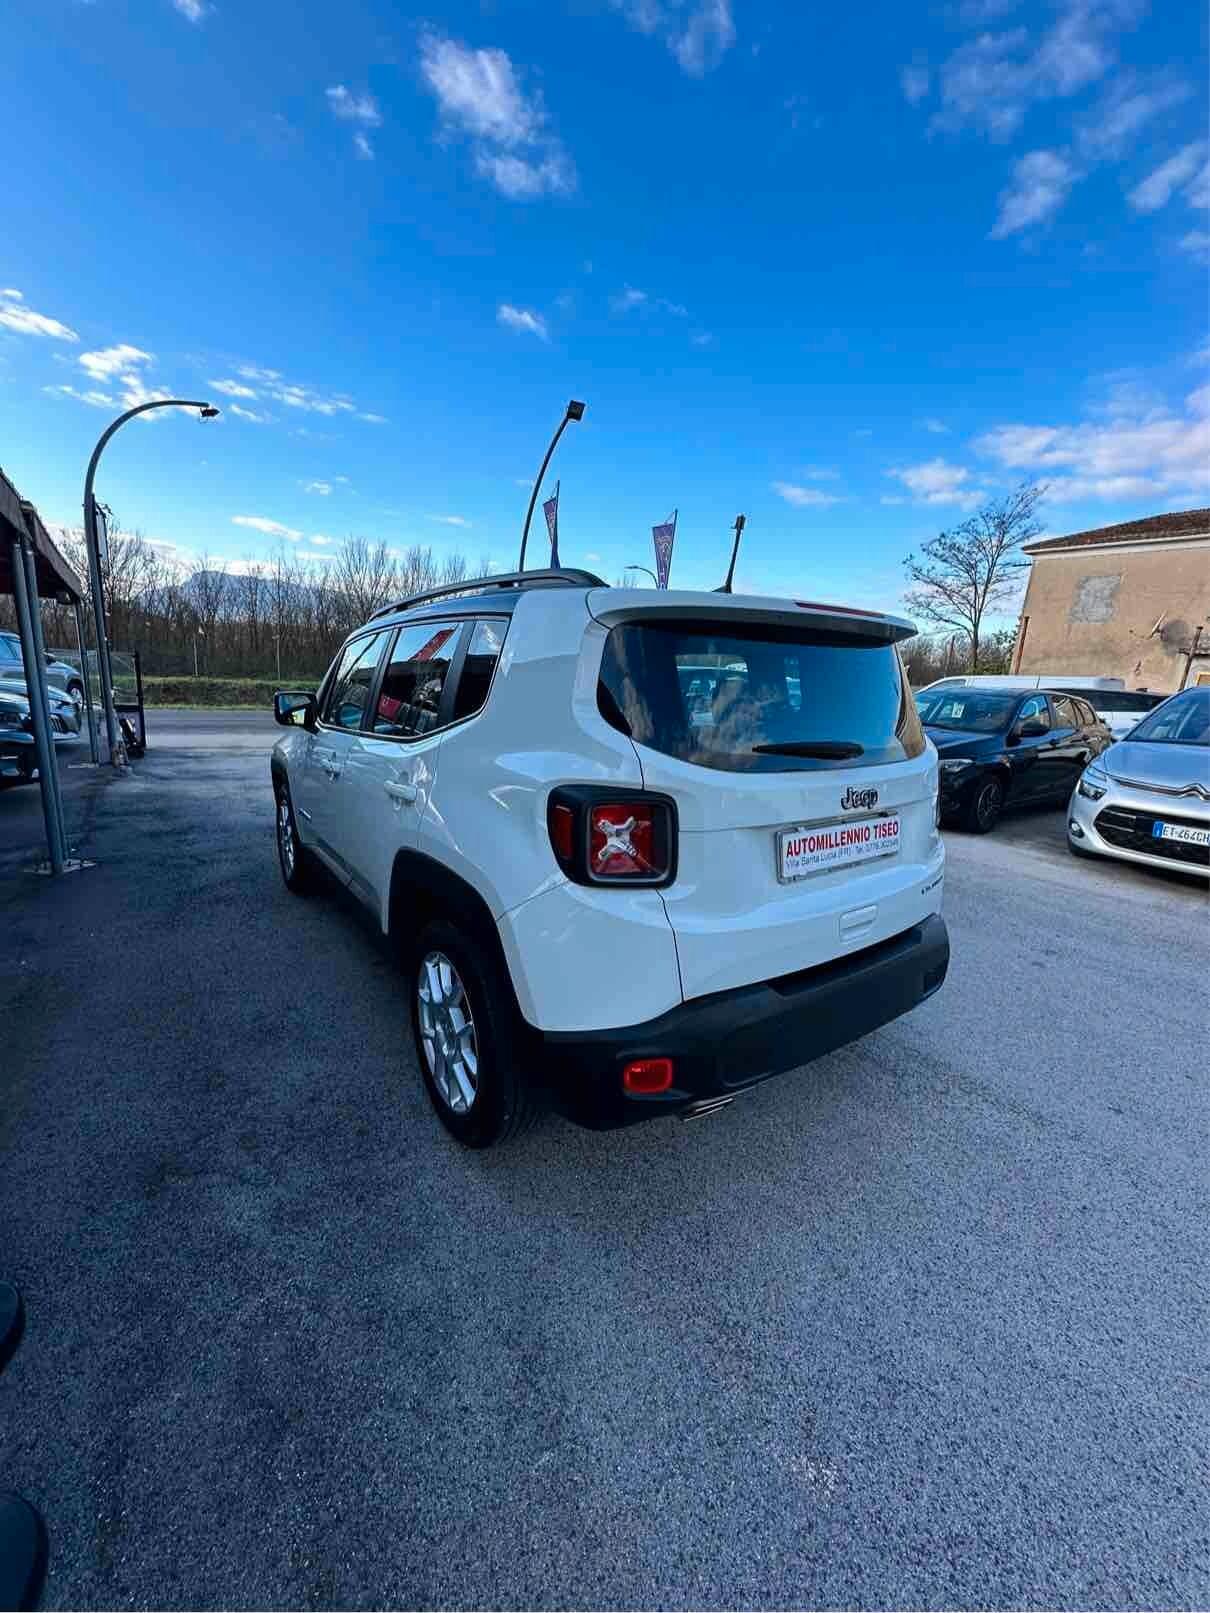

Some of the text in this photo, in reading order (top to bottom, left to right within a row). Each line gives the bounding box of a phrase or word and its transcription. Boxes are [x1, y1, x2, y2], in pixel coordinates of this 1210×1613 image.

[841, 787, 879, 809] Jeep
[786, 825, 871, 857] AUTOMILLENNIO
[873, 821, 899, 840] TISEO
